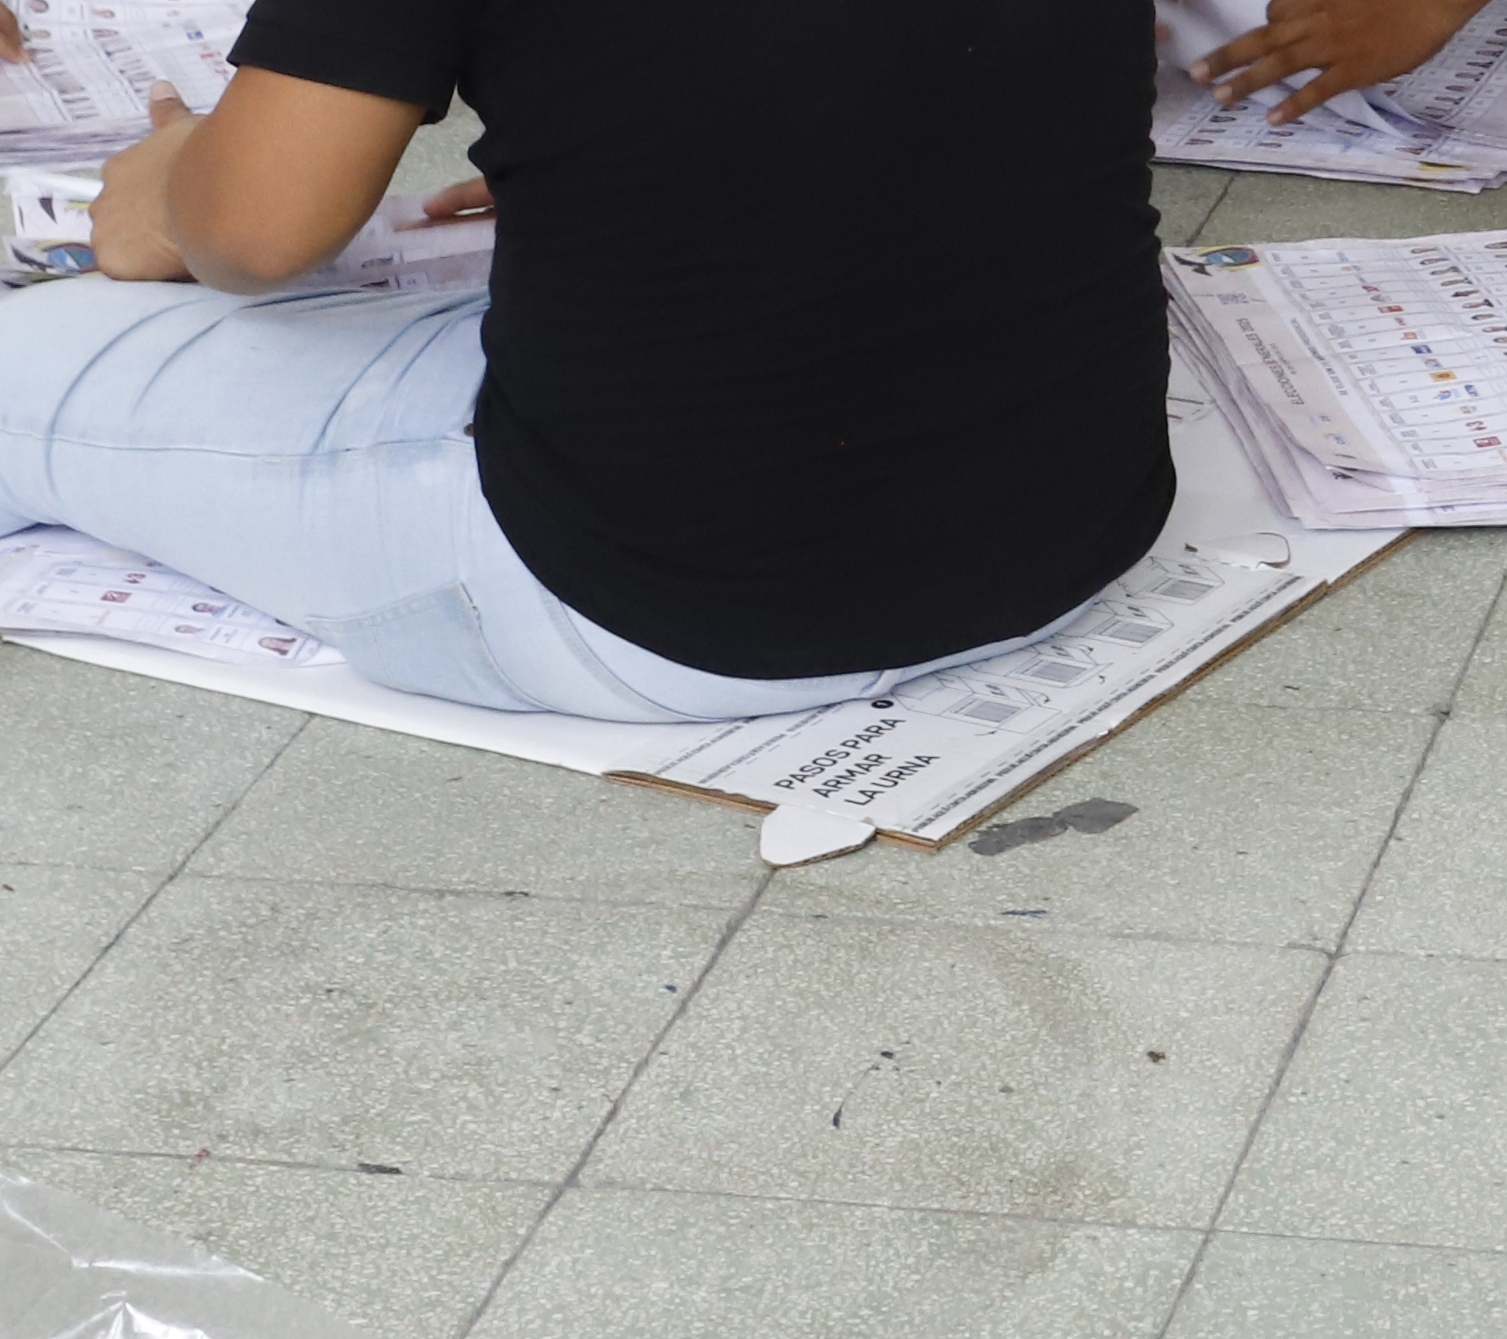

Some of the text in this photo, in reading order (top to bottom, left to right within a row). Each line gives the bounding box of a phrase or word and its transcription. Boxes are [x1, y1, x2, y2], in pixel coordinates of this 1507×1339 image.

[773, 749, 851, 790] PASOS
[840, 718, 907, 750] PARA
[812, 753, 893, 798] ARMAR
[844, 789, 885, 806] LA
[870, 755, 941, 788] URNA
